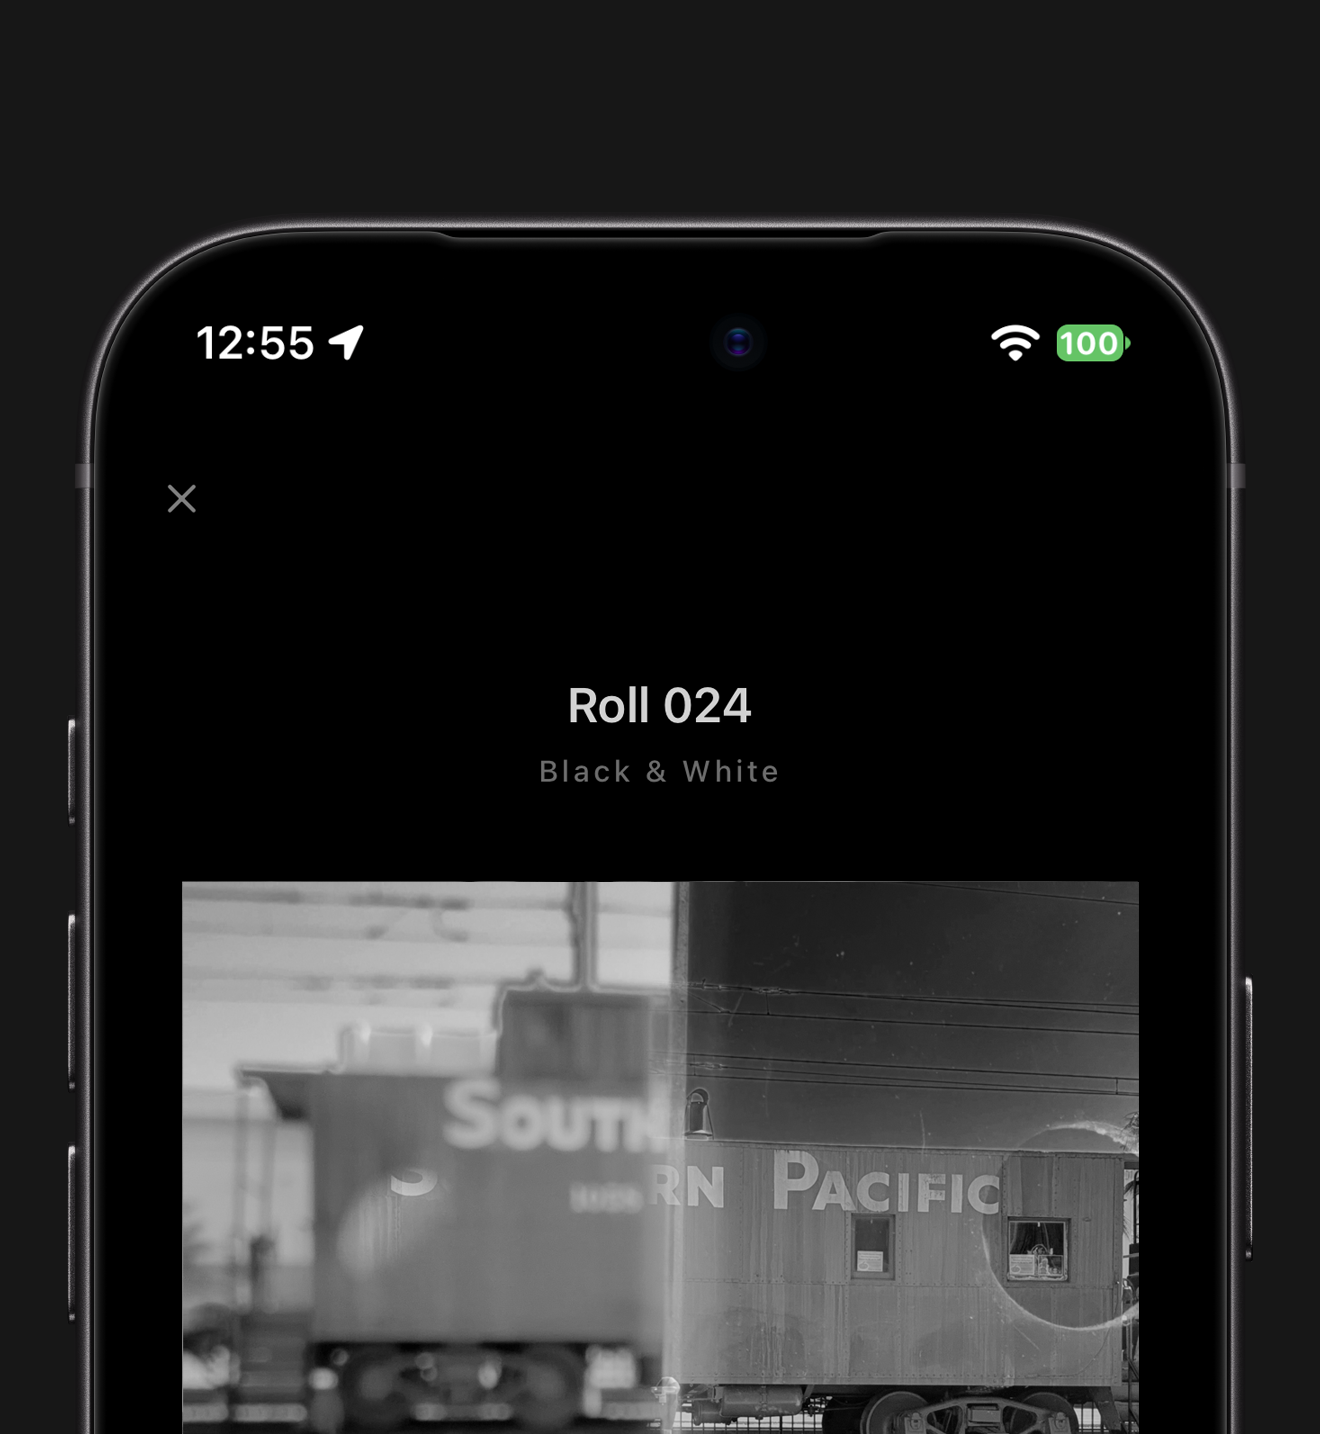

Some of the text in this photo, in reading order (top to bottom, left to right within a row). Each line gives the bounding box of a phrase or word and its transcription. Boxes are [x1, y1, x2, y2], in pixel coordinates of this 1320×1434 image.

[197, 325, 314, 360] 12:55
[1061, 332, 1117, 355] 100
[570, 686, 751, 723] Roll 024
[541, 759, 777, 782] Black & White
[773, 1150, 1000, 1215] PACIFIC
